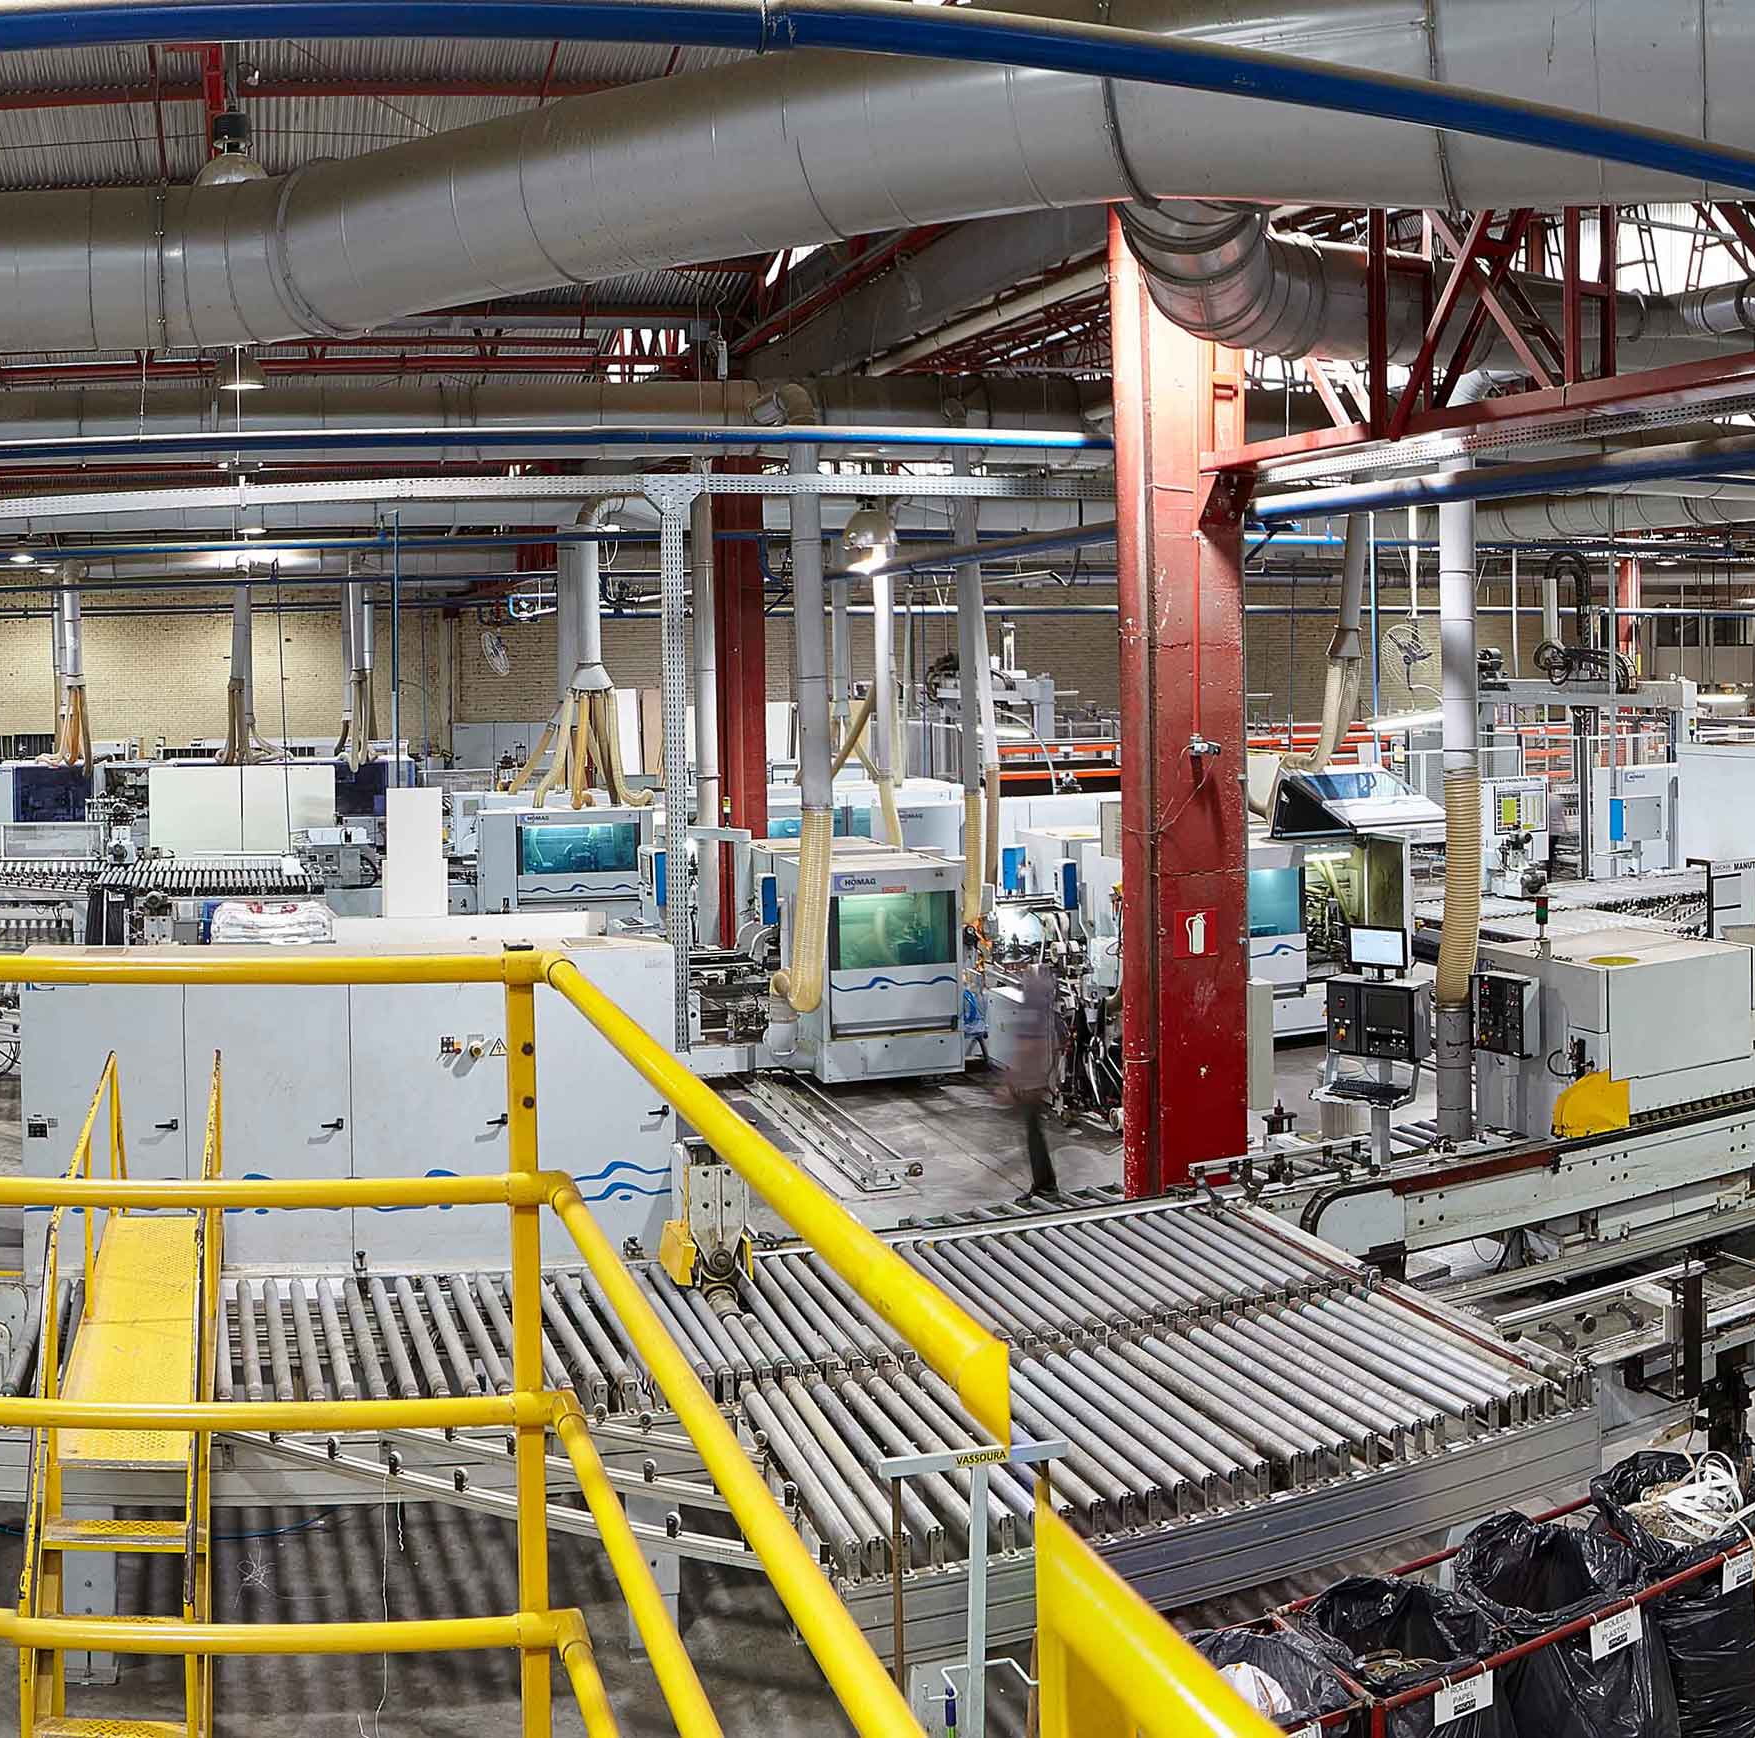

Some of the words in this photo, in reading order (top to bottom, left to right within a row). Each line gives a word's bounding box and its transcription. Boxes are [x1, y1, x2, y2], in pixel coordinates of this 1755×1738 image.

[845, 878, 876, 886] HOMAG
[1450, 1679, 1477, 1693] ROLETE
[1452, 1691, 1475, 1705] PAPEL
